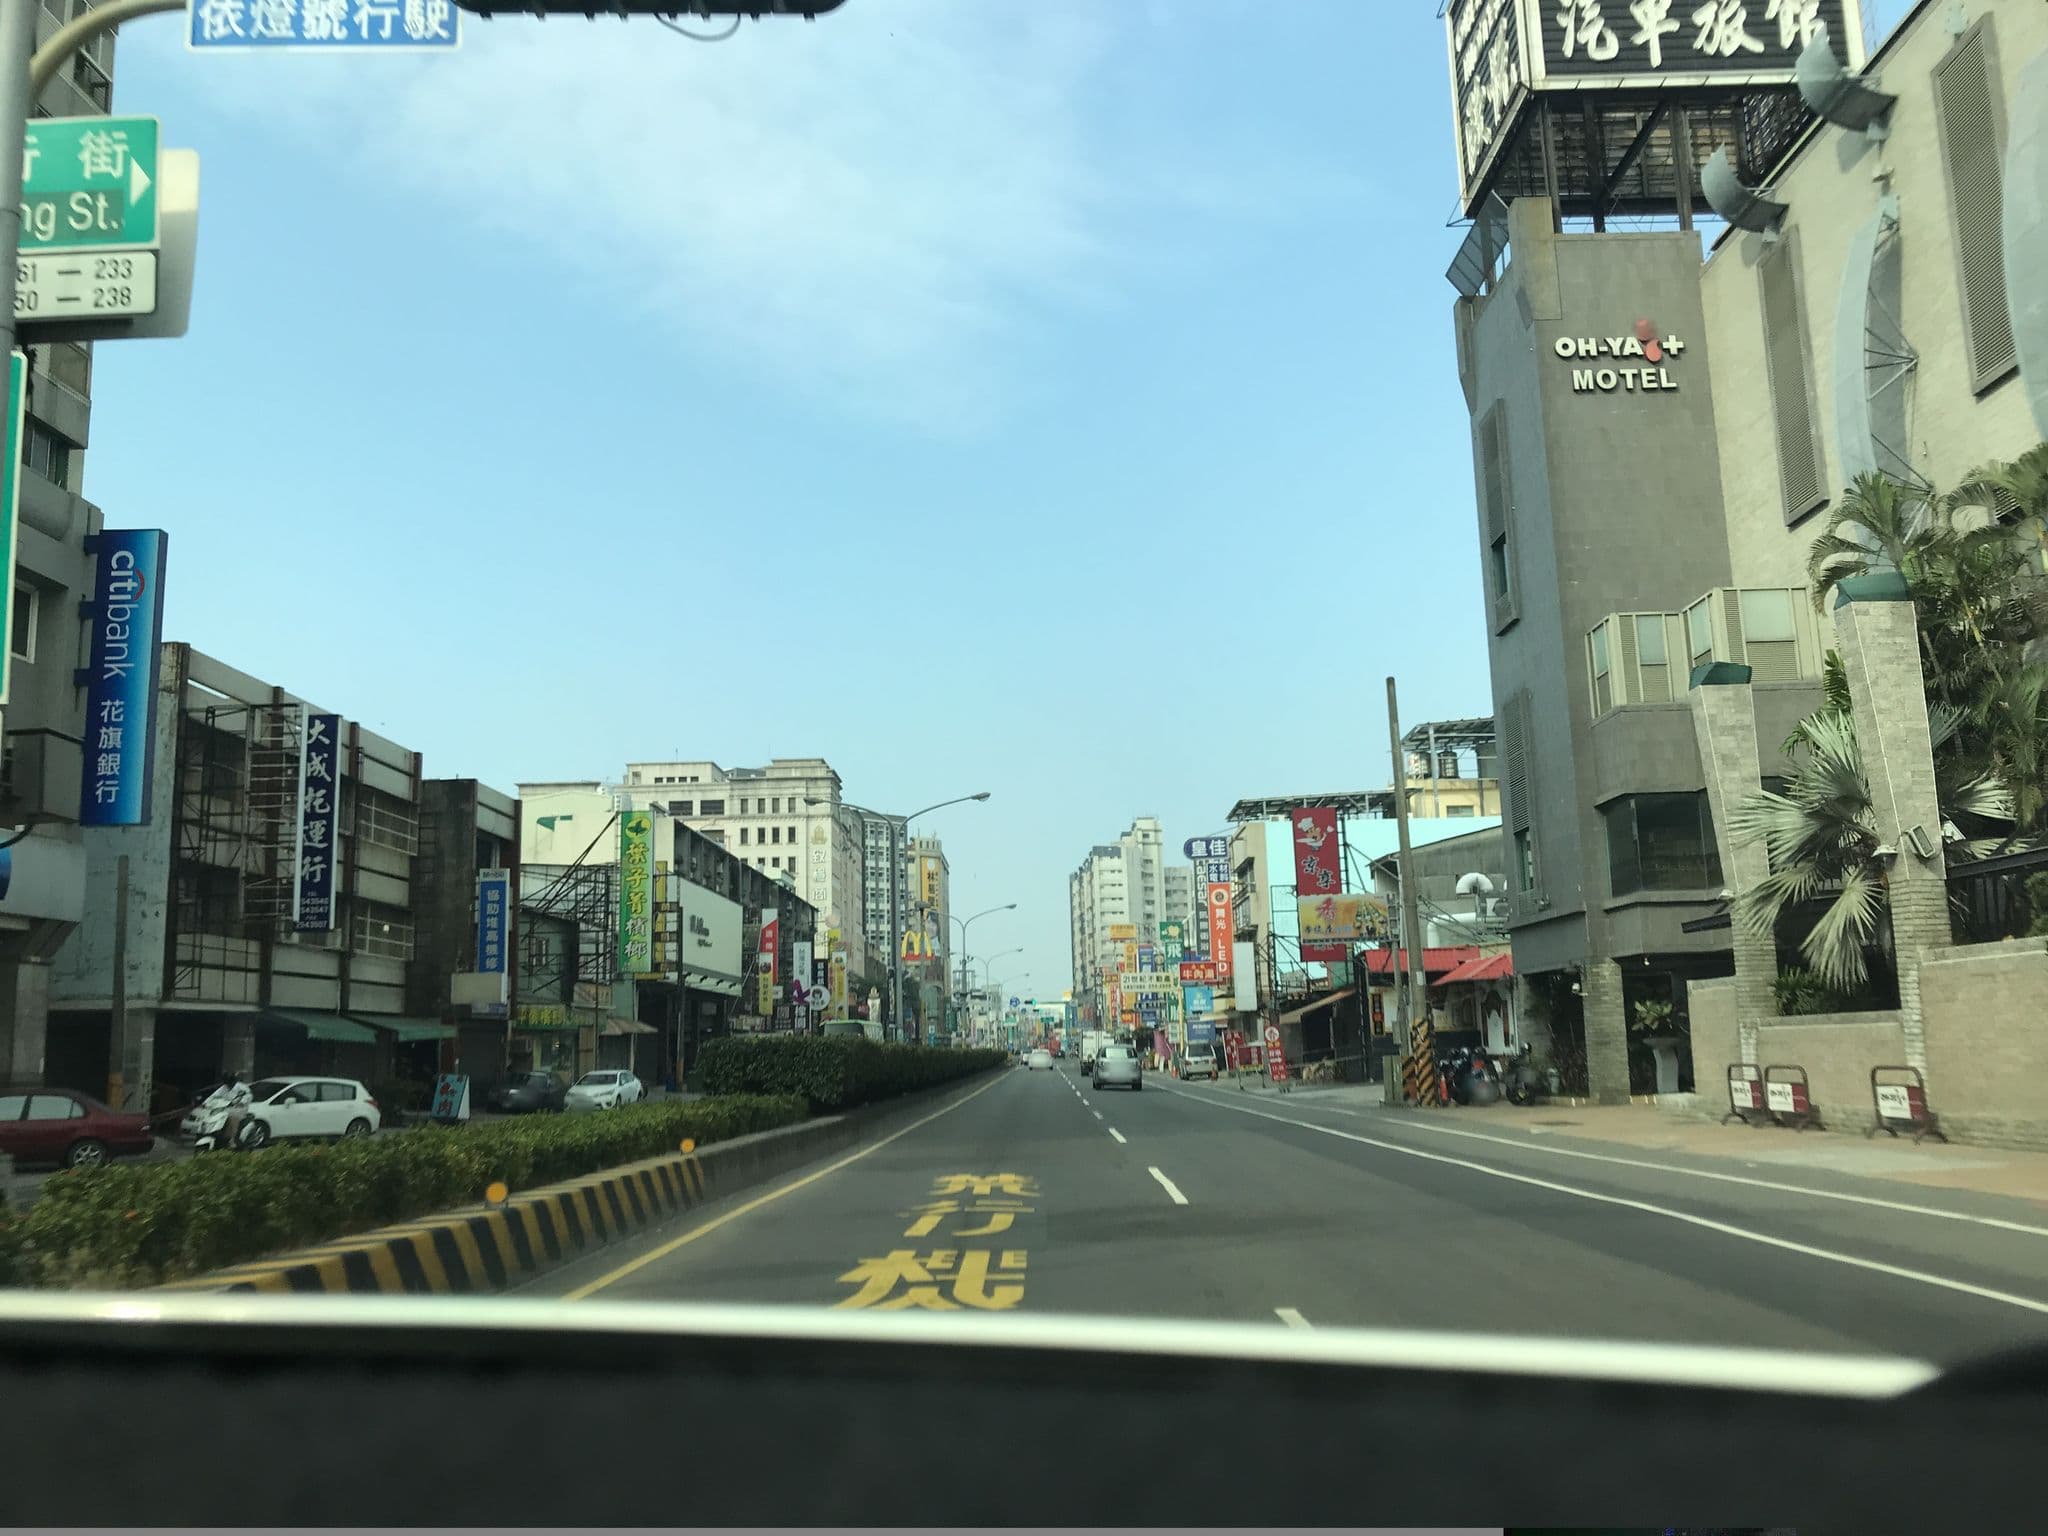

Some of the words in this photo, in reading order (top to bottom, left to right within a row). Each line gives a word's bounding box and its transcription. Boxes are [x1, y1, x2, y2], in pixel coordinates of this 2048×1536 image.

[199, 0, 451, 40] 依燈號行駛
[78, 129, 129, 179] 街
[68, 190, 120, 231] St.
[94, 258, 134, 281] 233
[93, 287, 132, 310] 238
[1573, 367, 1678, 391] MOTEL
[103, 549, 139, 680] citibank
[95, 699, 124, 805] 花旗銀行
[1191, 840, 1227, 857] 皇佳
